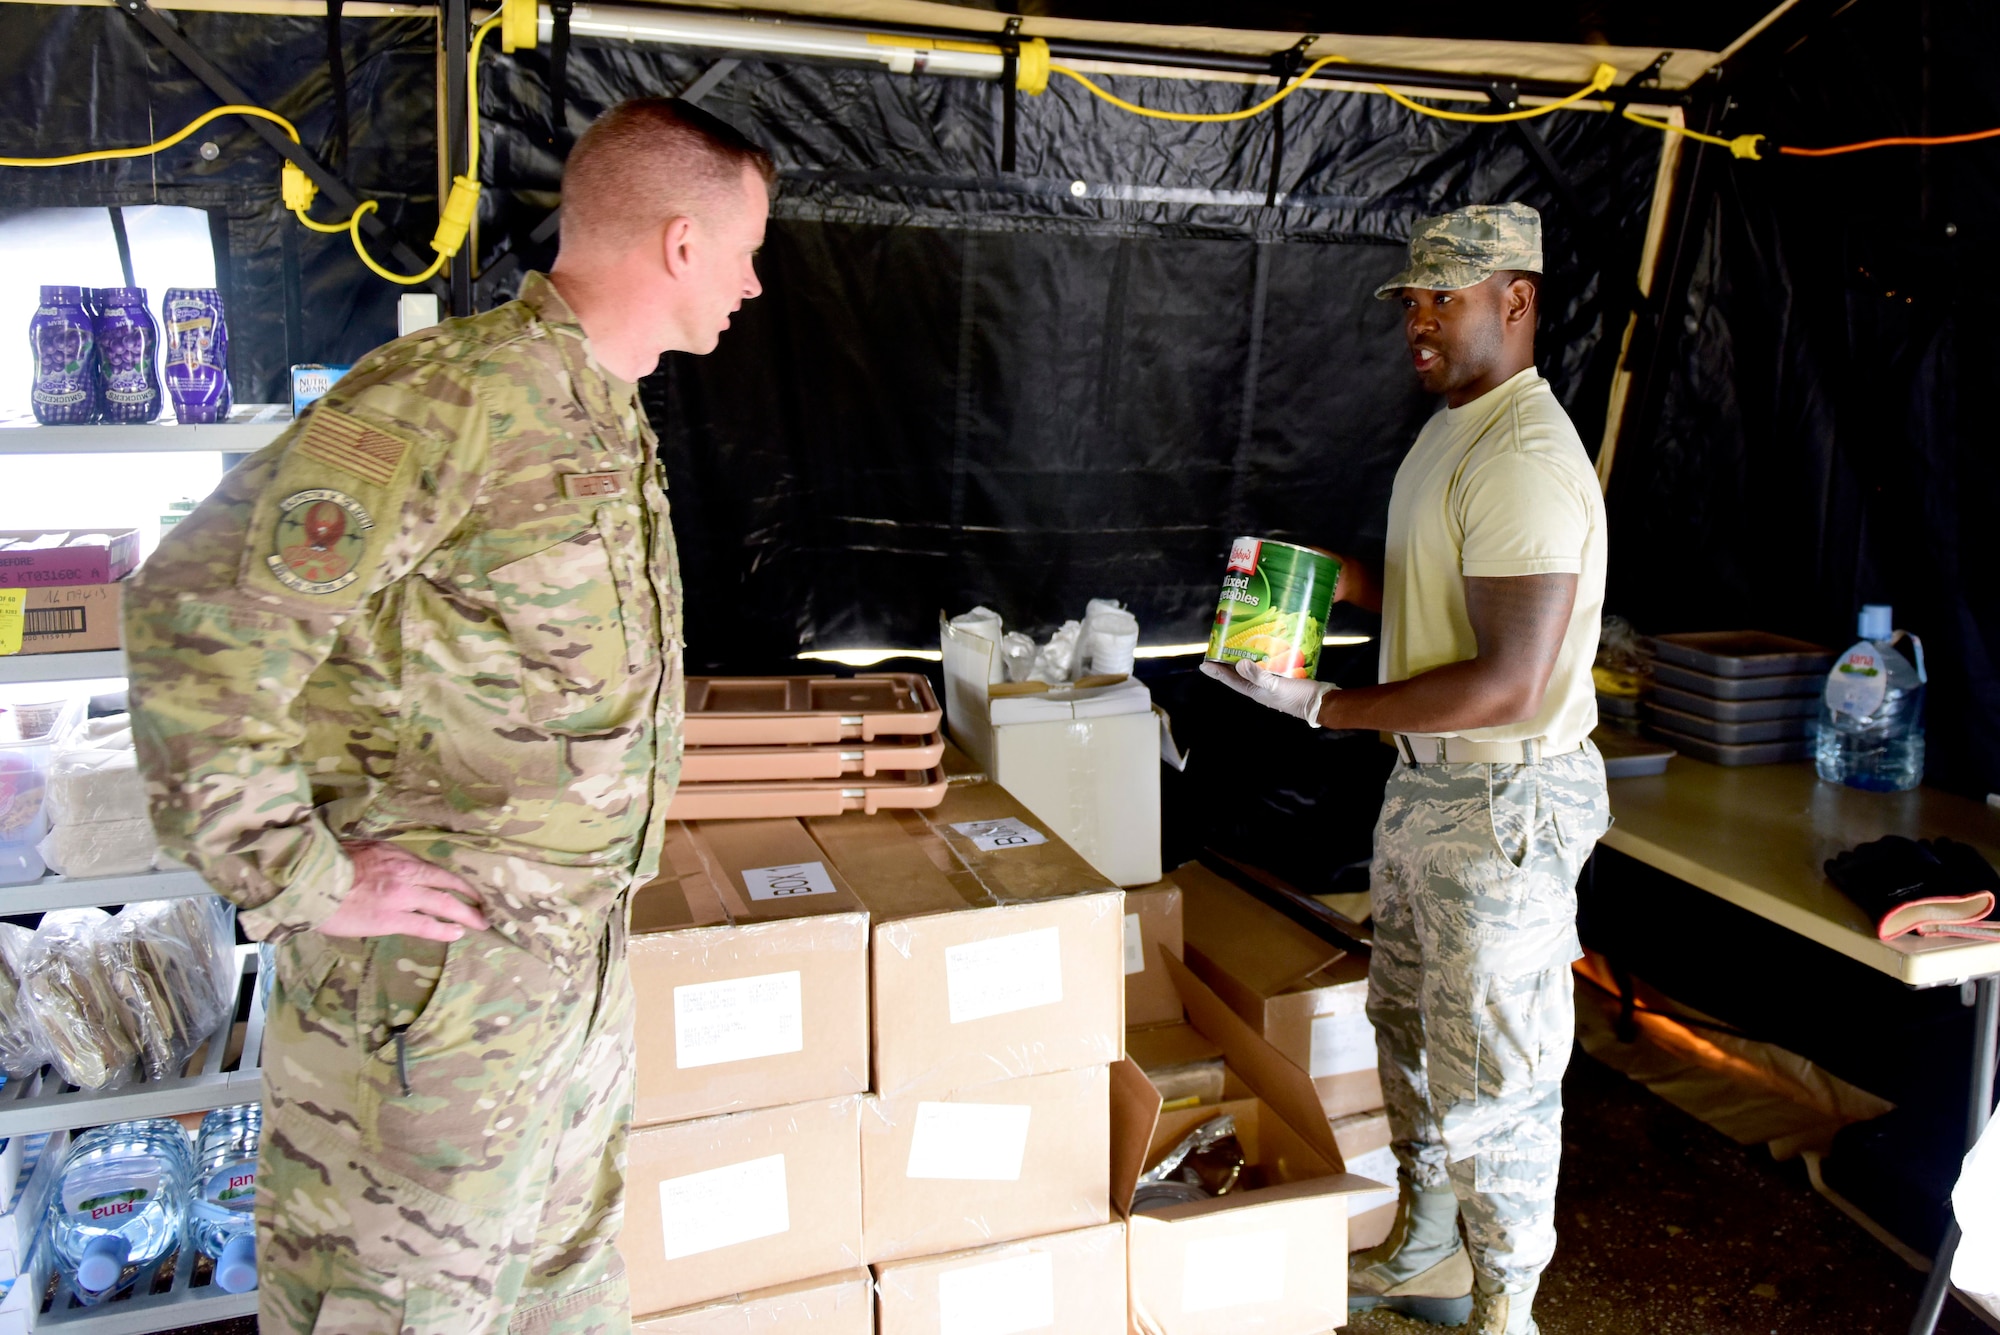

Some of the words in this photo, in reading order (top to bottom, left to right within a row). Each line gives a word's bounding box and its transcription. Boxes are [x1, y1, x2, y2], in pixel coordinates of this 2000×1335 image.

[299, 378, 328, 387] NUTRI
[299, 385, 329, 393] GRAIN
[91, 567, 101, 579] A
[764, 864, 803, 873] 1
[766, 871, 813, 896] BOX
[229, 1173, 255, 1191] jan
[91, 1199, 135, 1220] jana
